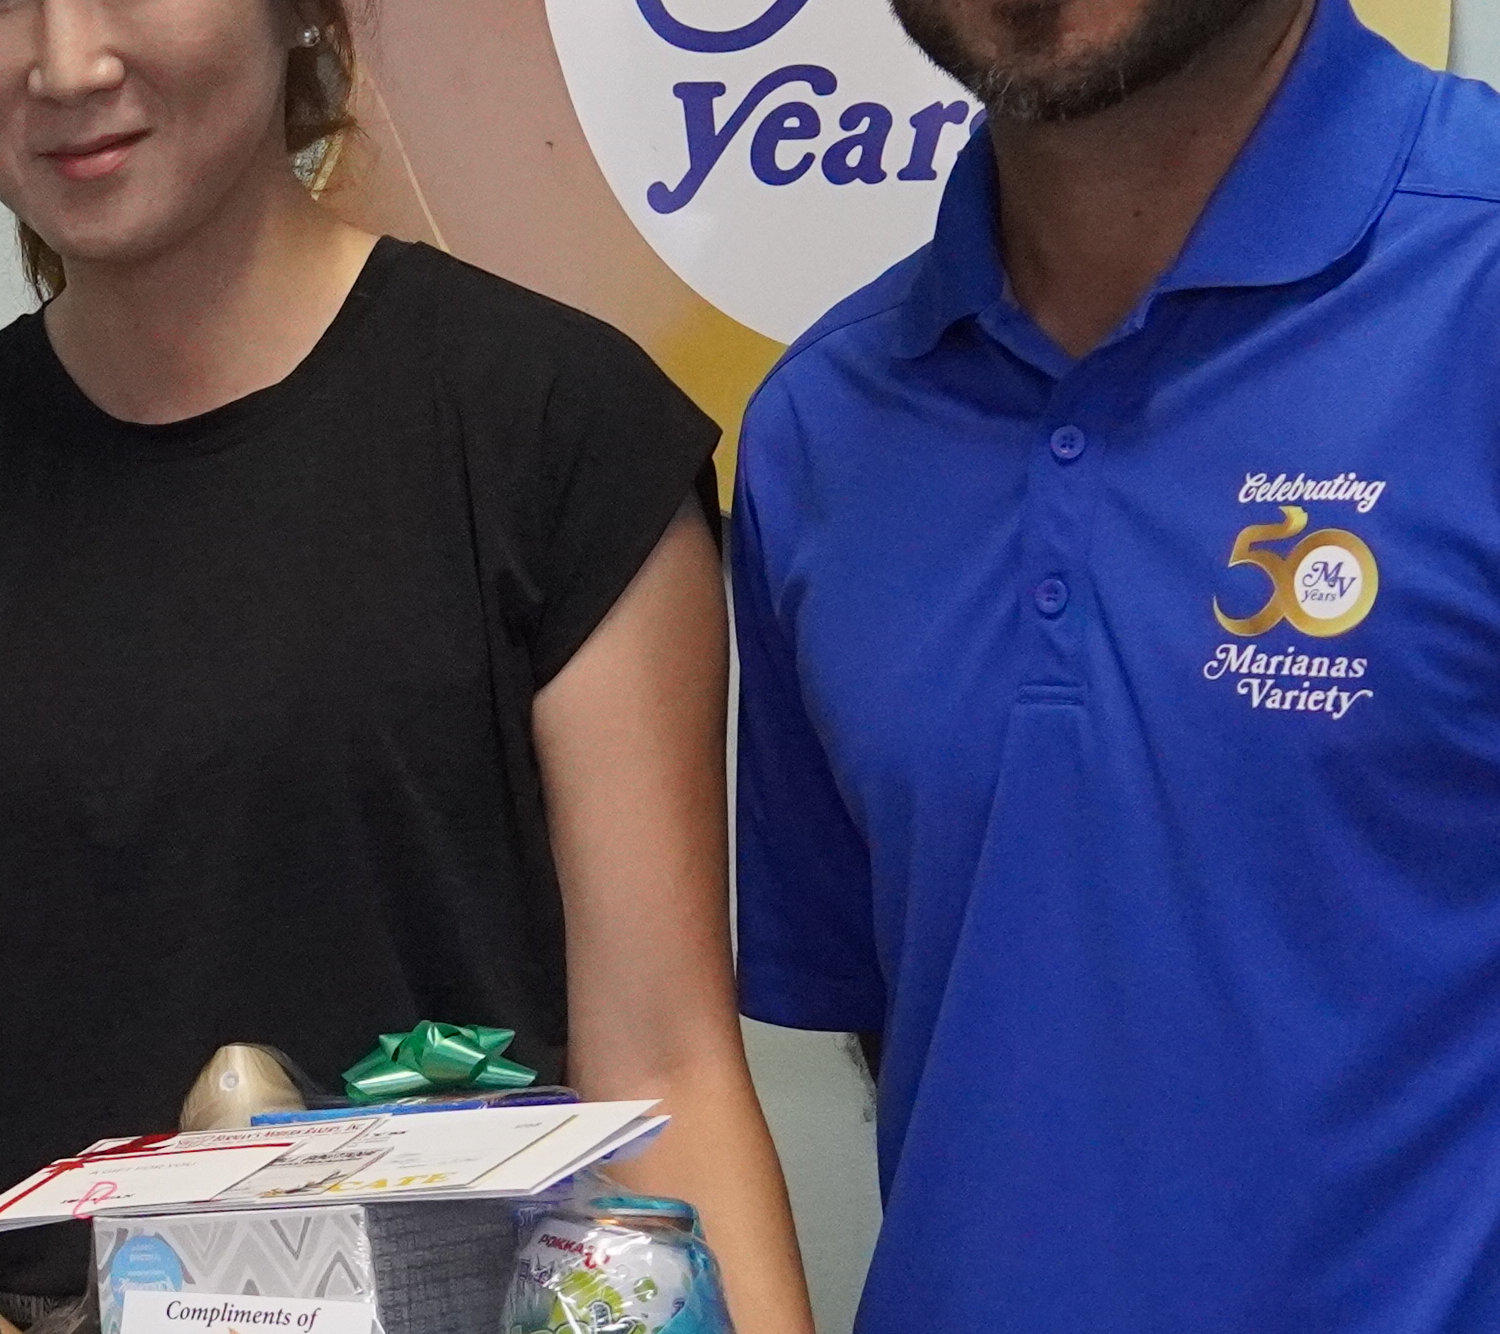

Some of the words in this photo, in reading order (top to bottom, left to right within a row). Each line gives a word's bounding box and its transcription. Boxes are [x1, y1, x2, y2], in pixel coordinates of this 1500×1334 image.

[646, 64, 990, 215] year
[1237, 472, 1387, 513] Celebrating
[1212, 505, 1379, 638] 50
[1300, 588, 1337, 603] years
[1203, 644, 1368, 680] Marianas
[1236, 678, 1374, 720] Variety
[538, 1233, 585, 1256] POKKA
[166, 1300, 291, 1328] Compliments
[296, 1307, 322, 1334] of
